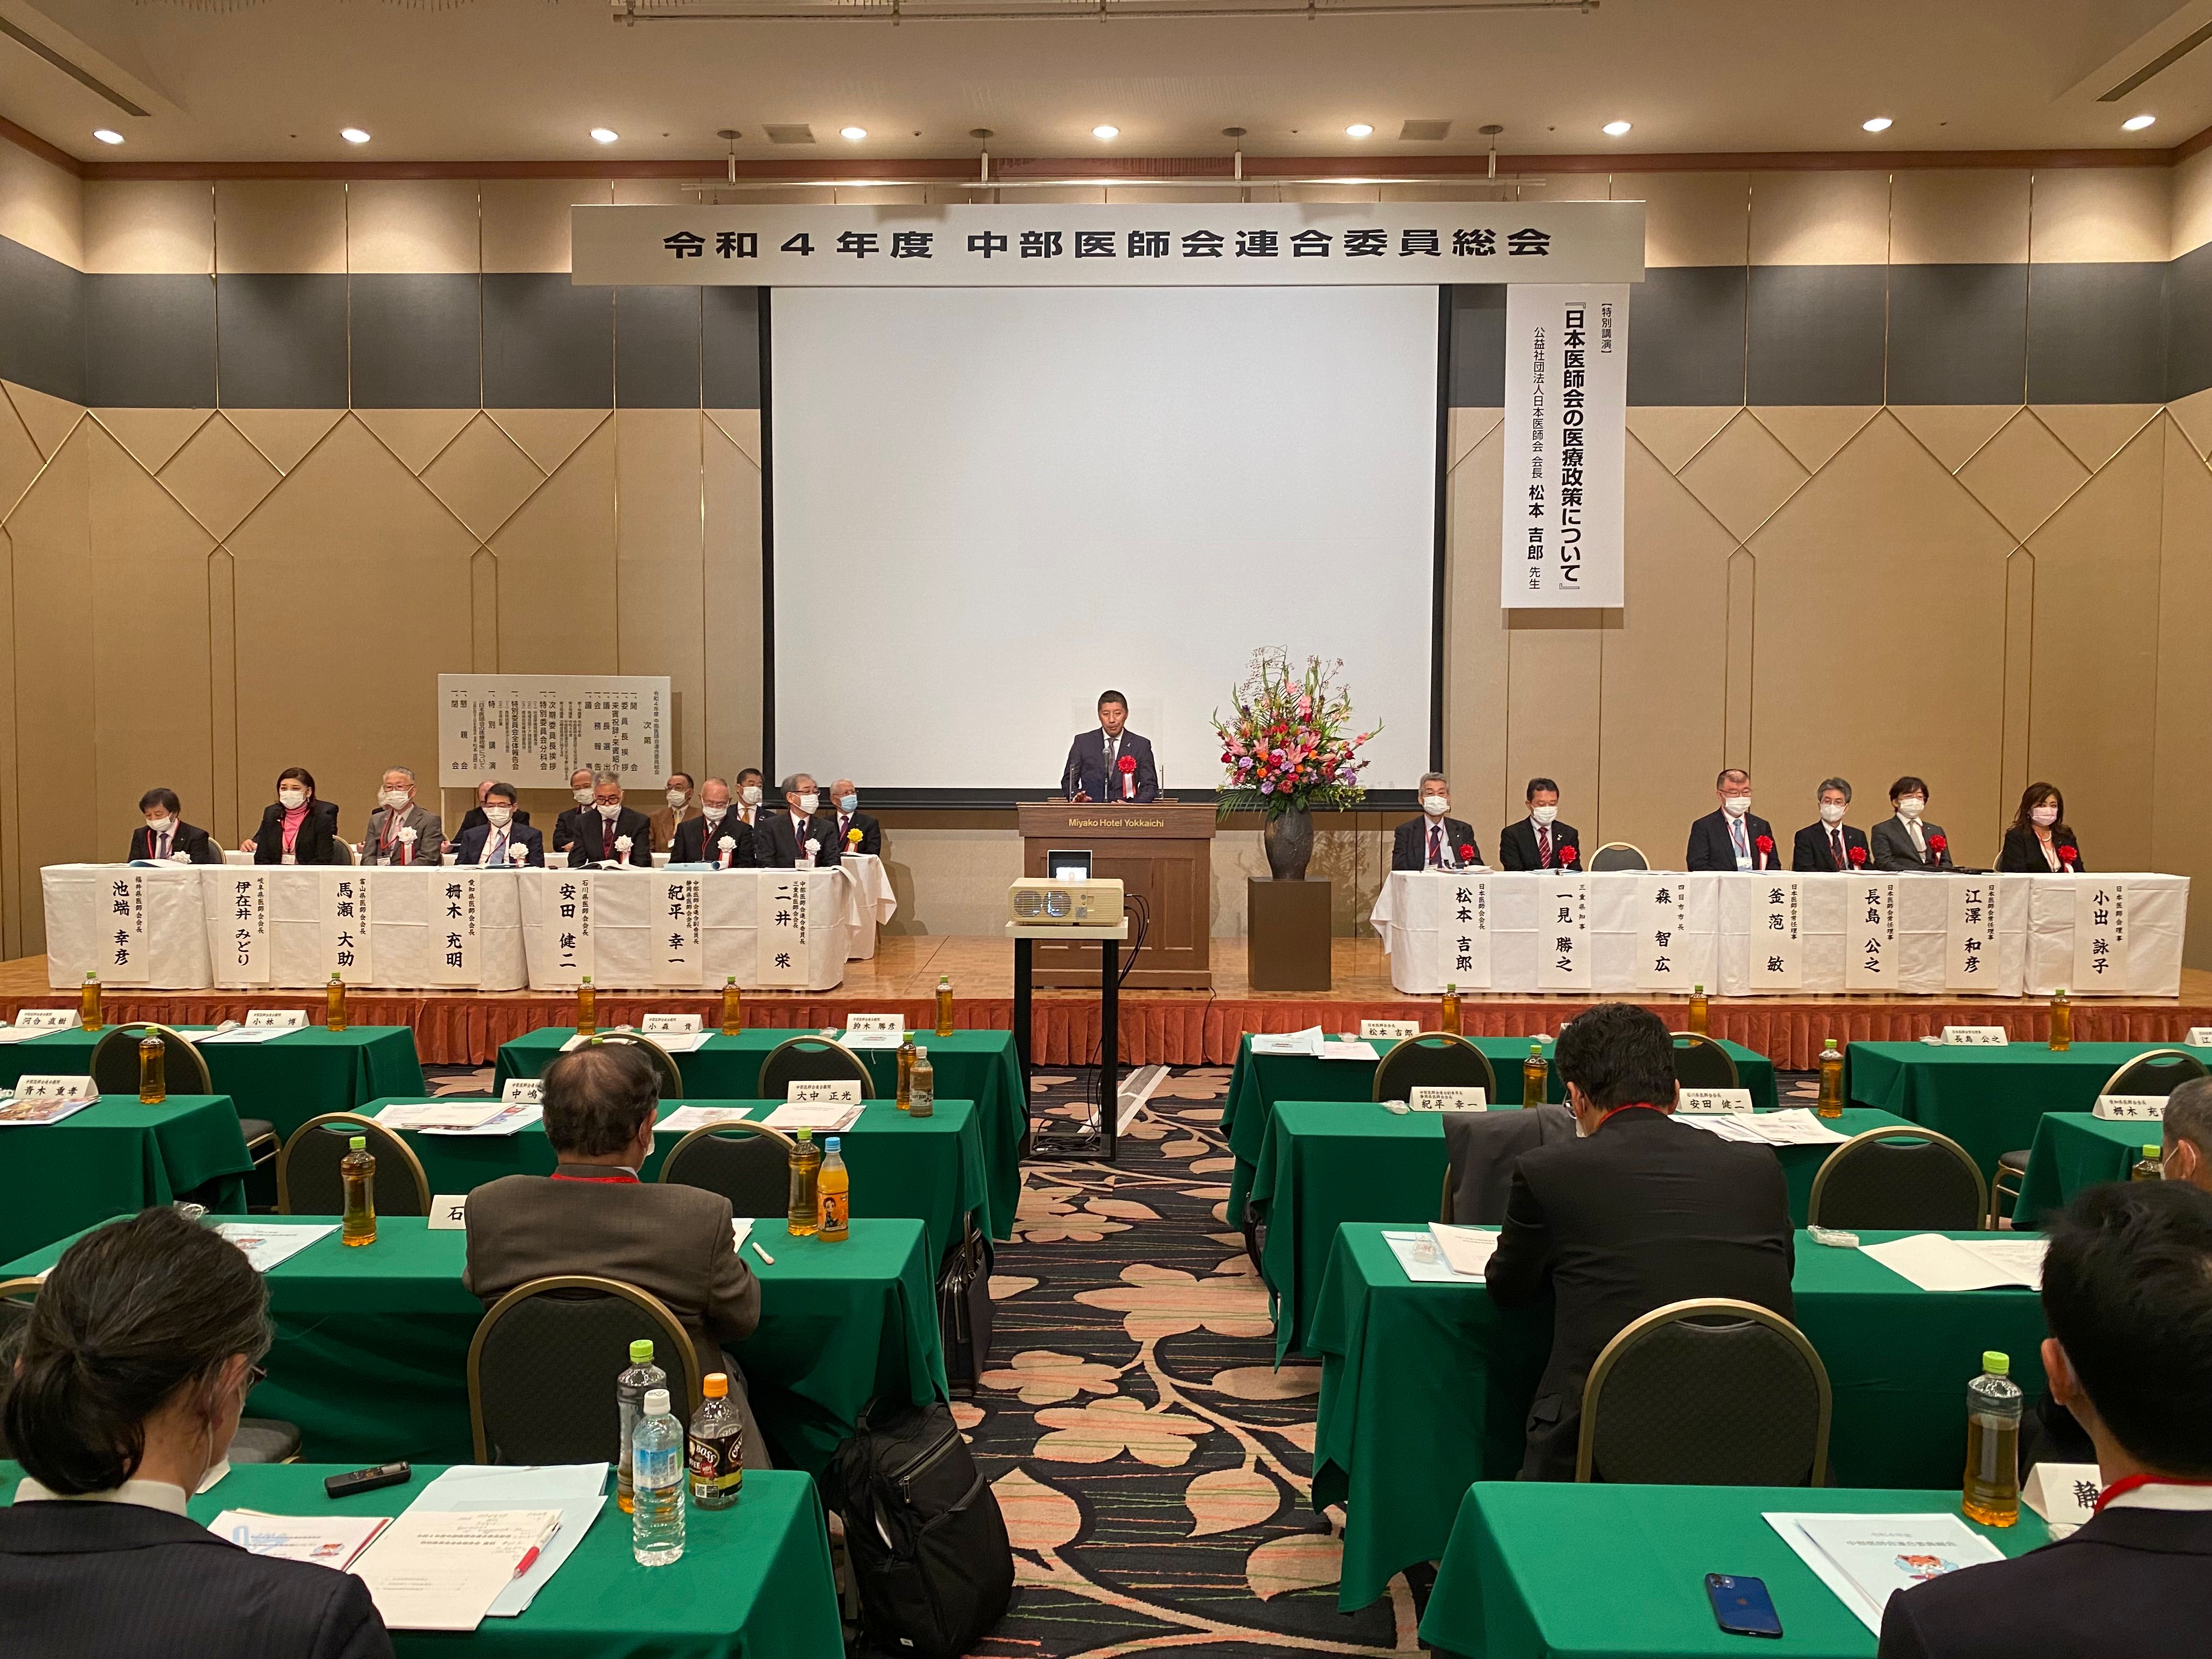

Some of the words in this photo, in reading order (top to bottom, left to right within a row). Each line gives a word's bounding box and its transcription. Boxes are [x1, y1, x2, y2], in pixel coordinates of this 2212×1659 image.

[966, 227, 1554, 259] 中部医師会連合委員総会
[1601, 302, 1612, 353] 【特別講演】
[1532, 326, 1545, 452] 公益社団法人日本医師会
[1560, 302, 1586, 590] 『日本医師会の医療政策について』
[1531, 456, 1543, 479] 会長
[1528, 484, 1544, 518] 松本
[1527, 527, 1544, 561] 吉郎
[1530, 567, 1541, 589] 先生
[1069, 819, 1098, 828] Miyako
[1099, 819, 1122, 827] Hotel
[1124, 819, 1164, 828] Yokkaichi
[112, 880, 129, 916] 池端
[235, 881, 252, 920] 伊在井
[337, 882, 354, 918] 馬瀬
[559, 883, 576, 918] 安田
[668, 884, 685, 920] 紀平
[775, 886, 791, 926] 二井
[1455, 887, 1472, 923] 松本
[1556, 894, 1573, 923] 一見
[1655, 888, 1672, 904] 森
[1865, 889, 1881, 924] 長島
[1965, 889, 1982, 924] 江澤
[2093, 889, 2109, 926] 小出
[114, 929, 129, 966] 幸彦
[235, 929, 251, 966] みどり
[337, 931, 354, 967] 大助
[446, 932, 462, 968] 充明
[559, 933, 576, 967] 健二
[668, 933, 685, 963] 幸一
[775, 952, 791, 969] 栄
[1456, 935, 1472, 972] 吉郎
[1555, 936, 1573, 972] 勝之
[1655, 930, 1671, 972] 智広
[1767, 956, 1784, 972] 敏
[1864, 938, 1881, 973] 公之
[1964, 938, 1982, 973] 和彦
[2092, 939, 2109, 974] 詠子
[25, 1086, 46, 1096] 青木
[797, 1091, 819, 1101] 大中
[829, 1091, 851, 1101] 正光
[1422, 1099, 1445, 1109] 紀平
[1454, 1099, 1477, 1109] 幸一
[1690, 1099, 1711, 1109] 安田
[1722, 1099, 1744, 1109] 健二
[447, 1206, 465, 1220] 石
[696, 1444, 716, 1463] BOSS
[2073, 1480, 2099, 1509] 静
